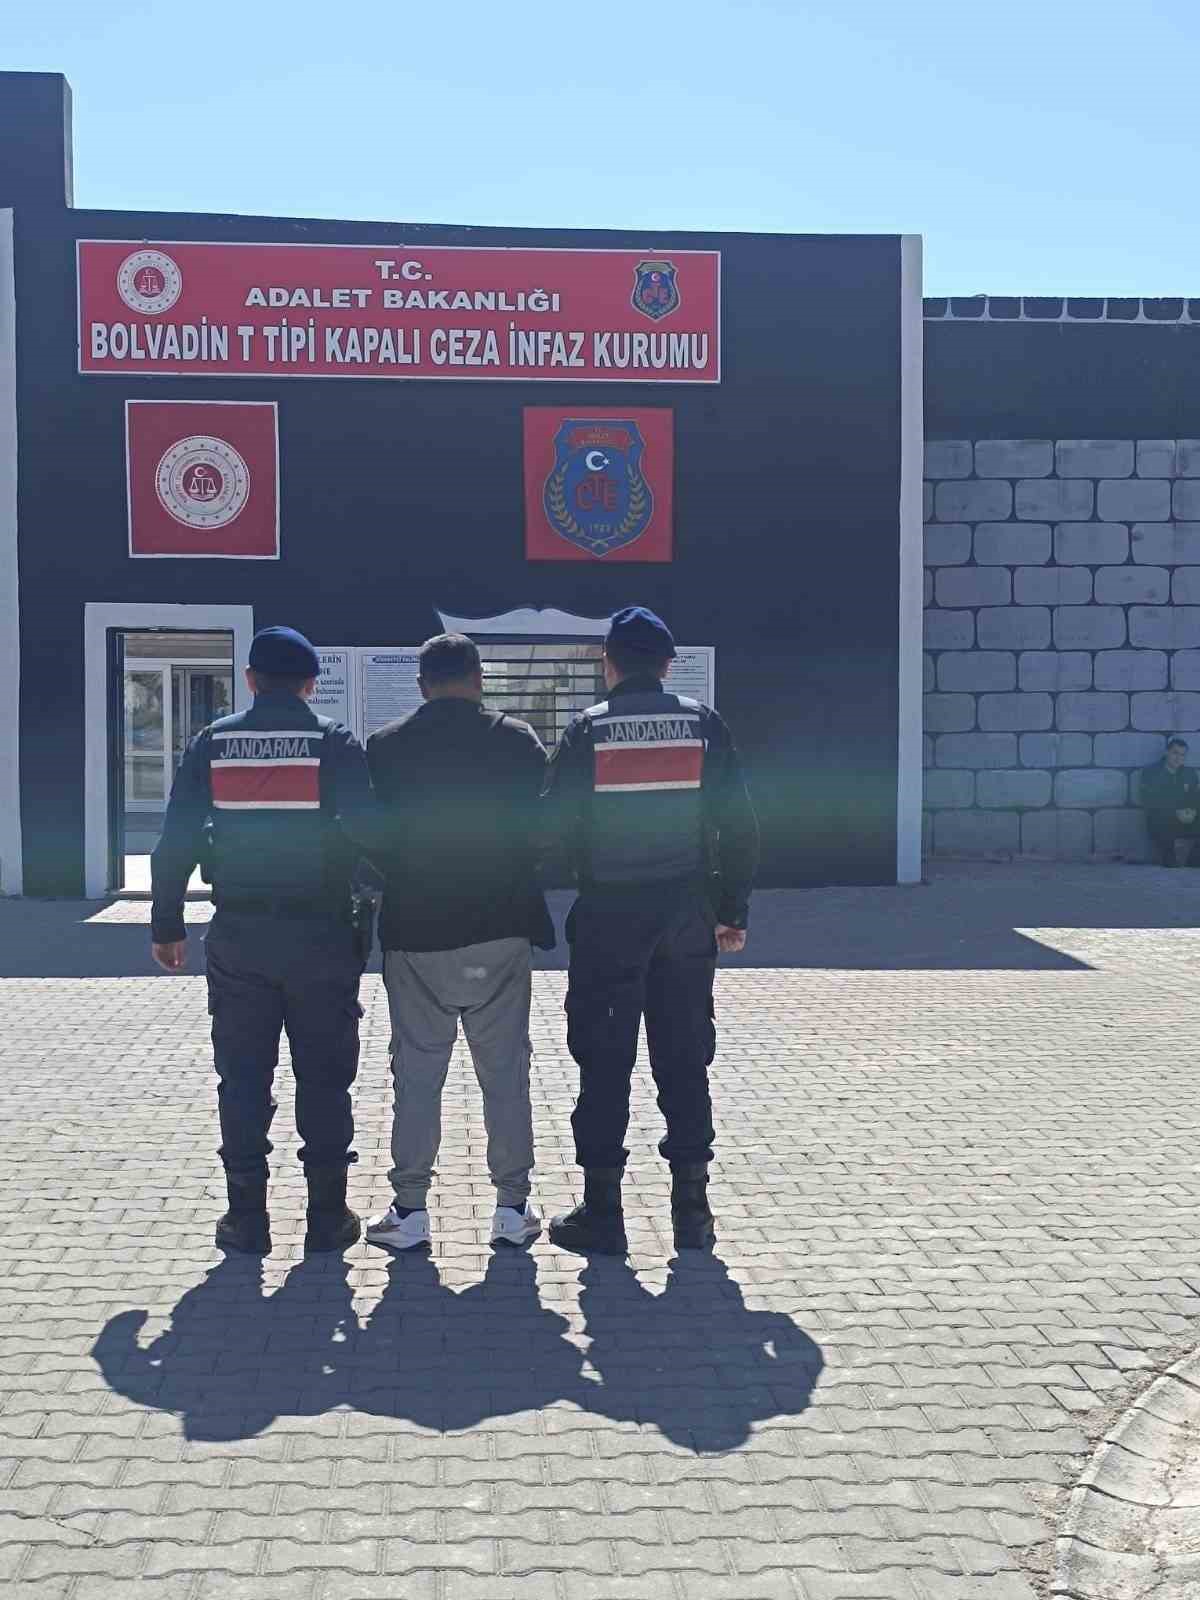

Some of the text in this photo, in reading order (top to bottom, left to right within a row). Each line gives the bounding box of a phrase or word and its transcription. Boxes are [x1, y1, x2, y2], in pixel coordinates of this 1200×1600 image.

[374, 260, 433, 280] T.C.
[244, 287, 560, 312] ADALET BAKANLIĞI
[91, 316, 708, 369] BOLVADİN T TİPİ KAPALI CEZA İNFAZ KURUMU
[606, 720, 694, 741] JANDARMA
[220, 738, 310, 759] JANDARMA
